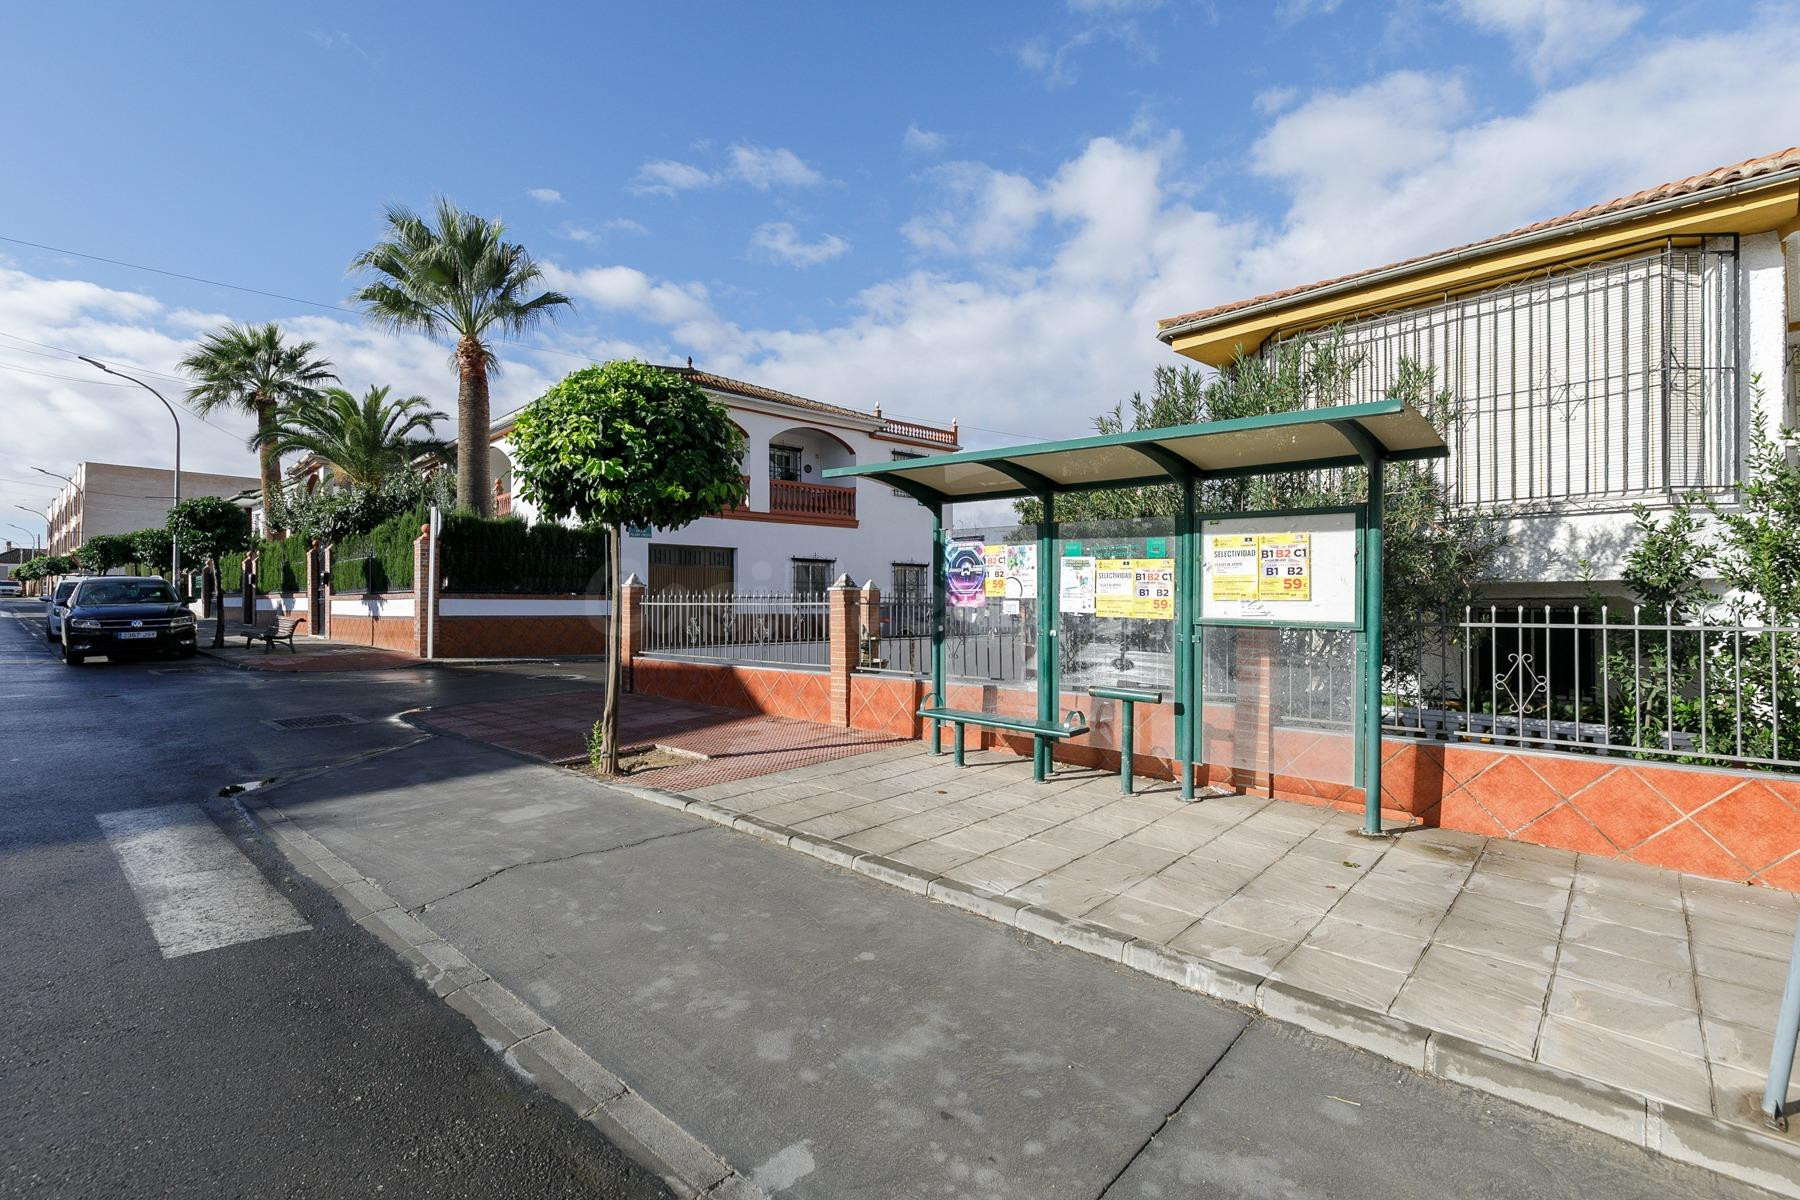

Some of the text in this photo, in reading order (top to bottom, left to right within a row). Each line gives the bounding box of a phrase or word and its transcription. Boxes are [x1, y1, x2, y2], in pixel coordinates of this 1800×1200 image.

[1214, 549, 1256, 558] SELECTIVIDAD
[1261, 548, 1307, 559] B1 B2 C1
[1098, 571, 1132, 579] SELECTIVIDAD
[1266, 566, 1303, 576] B1 B2
[1135, 573, 1172, 581] B1 B2 C1
[992, 580, 1004, 588] 59
[1283, 578, 1302, 590] 59
[1139, 589, 1169, 597] B1 B2
[1153, 599, 1168, 609] 59
